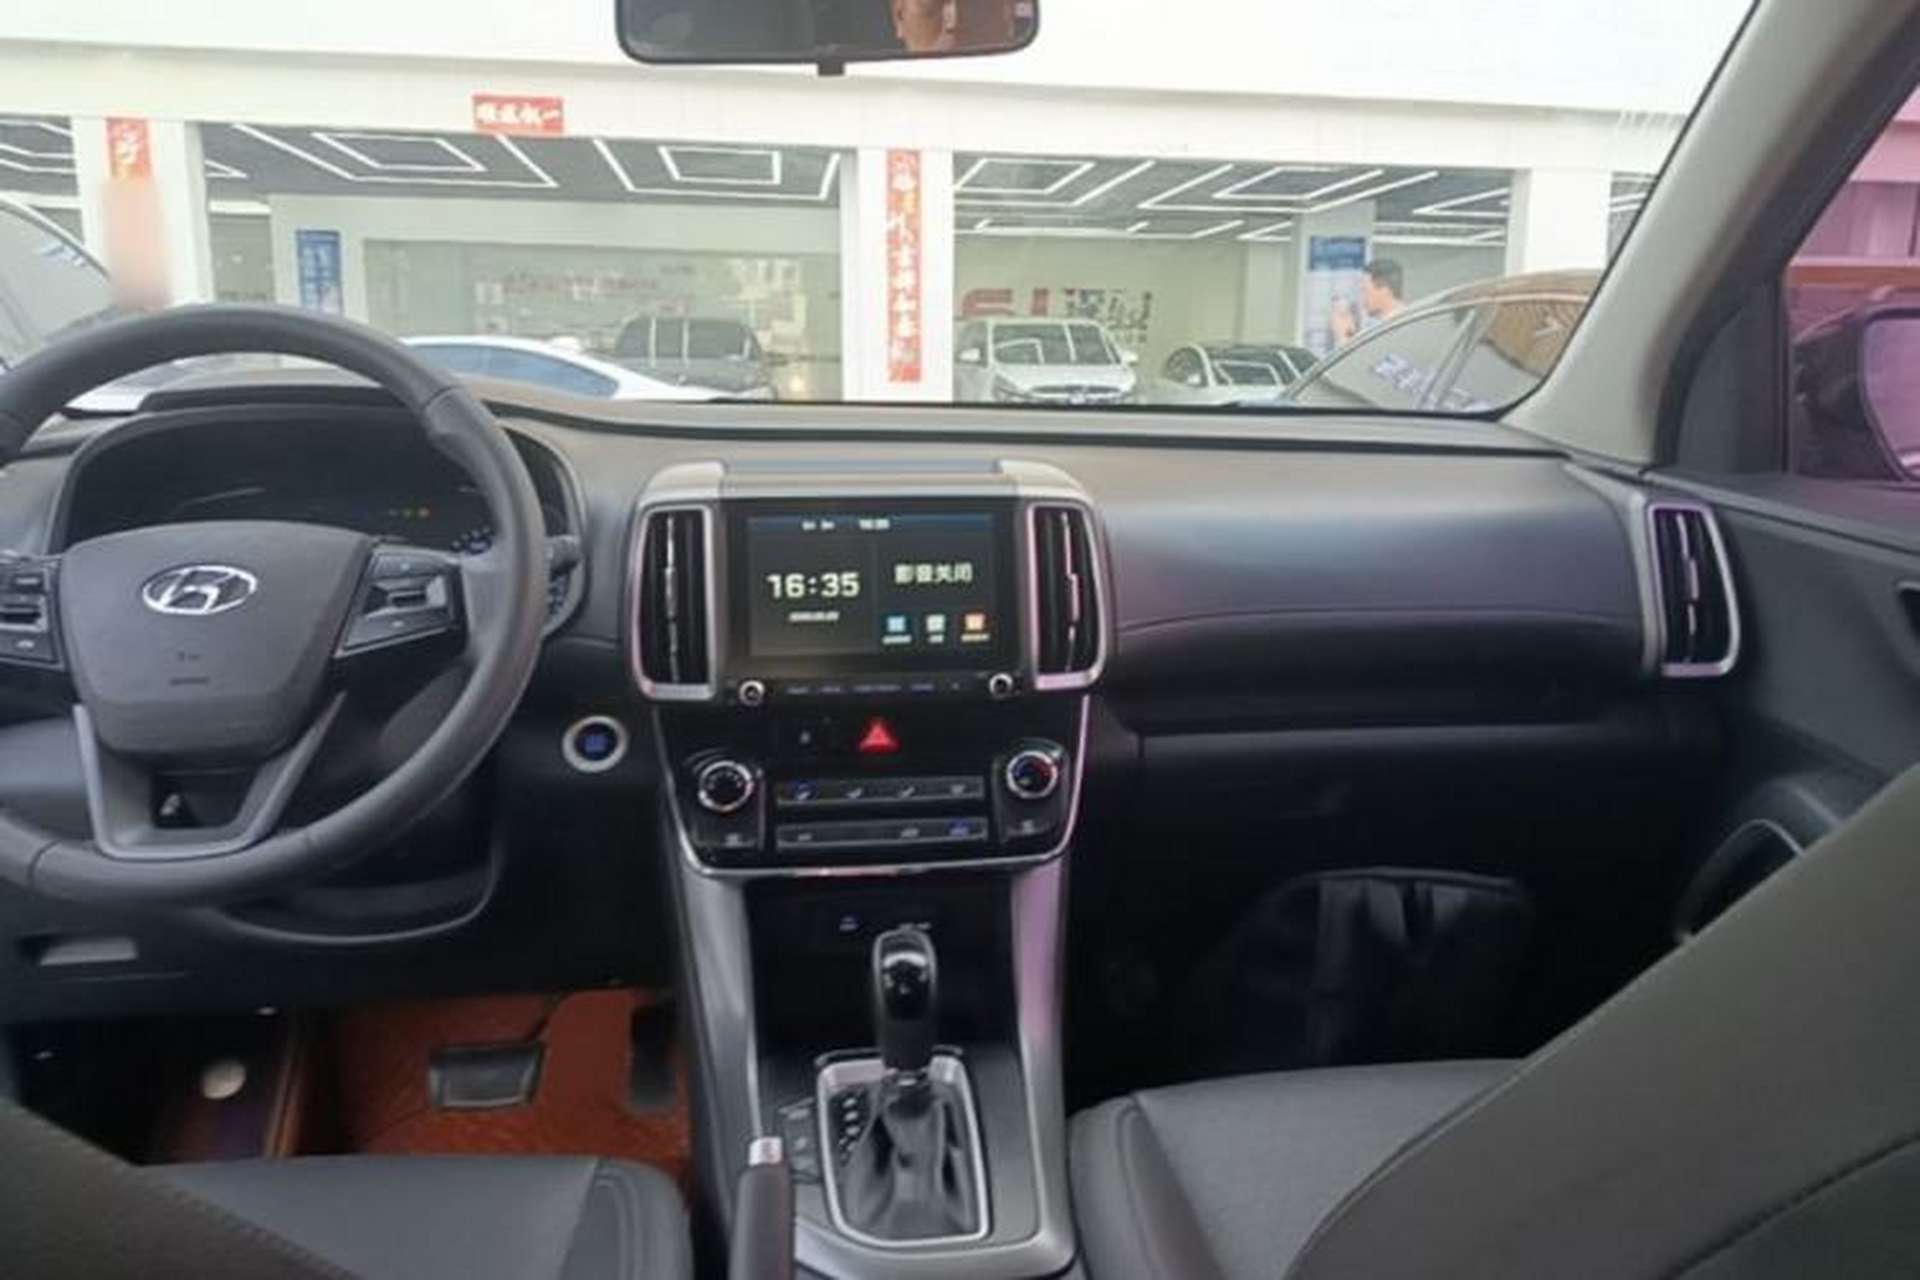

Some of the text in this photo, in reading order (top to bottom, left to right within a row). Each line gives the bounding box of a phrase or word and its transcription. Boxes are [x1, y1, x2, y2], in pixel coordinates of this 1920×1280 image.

[766, 571, 861, 600] 16:35
[894, 562, 973, 584] 影音关闭
